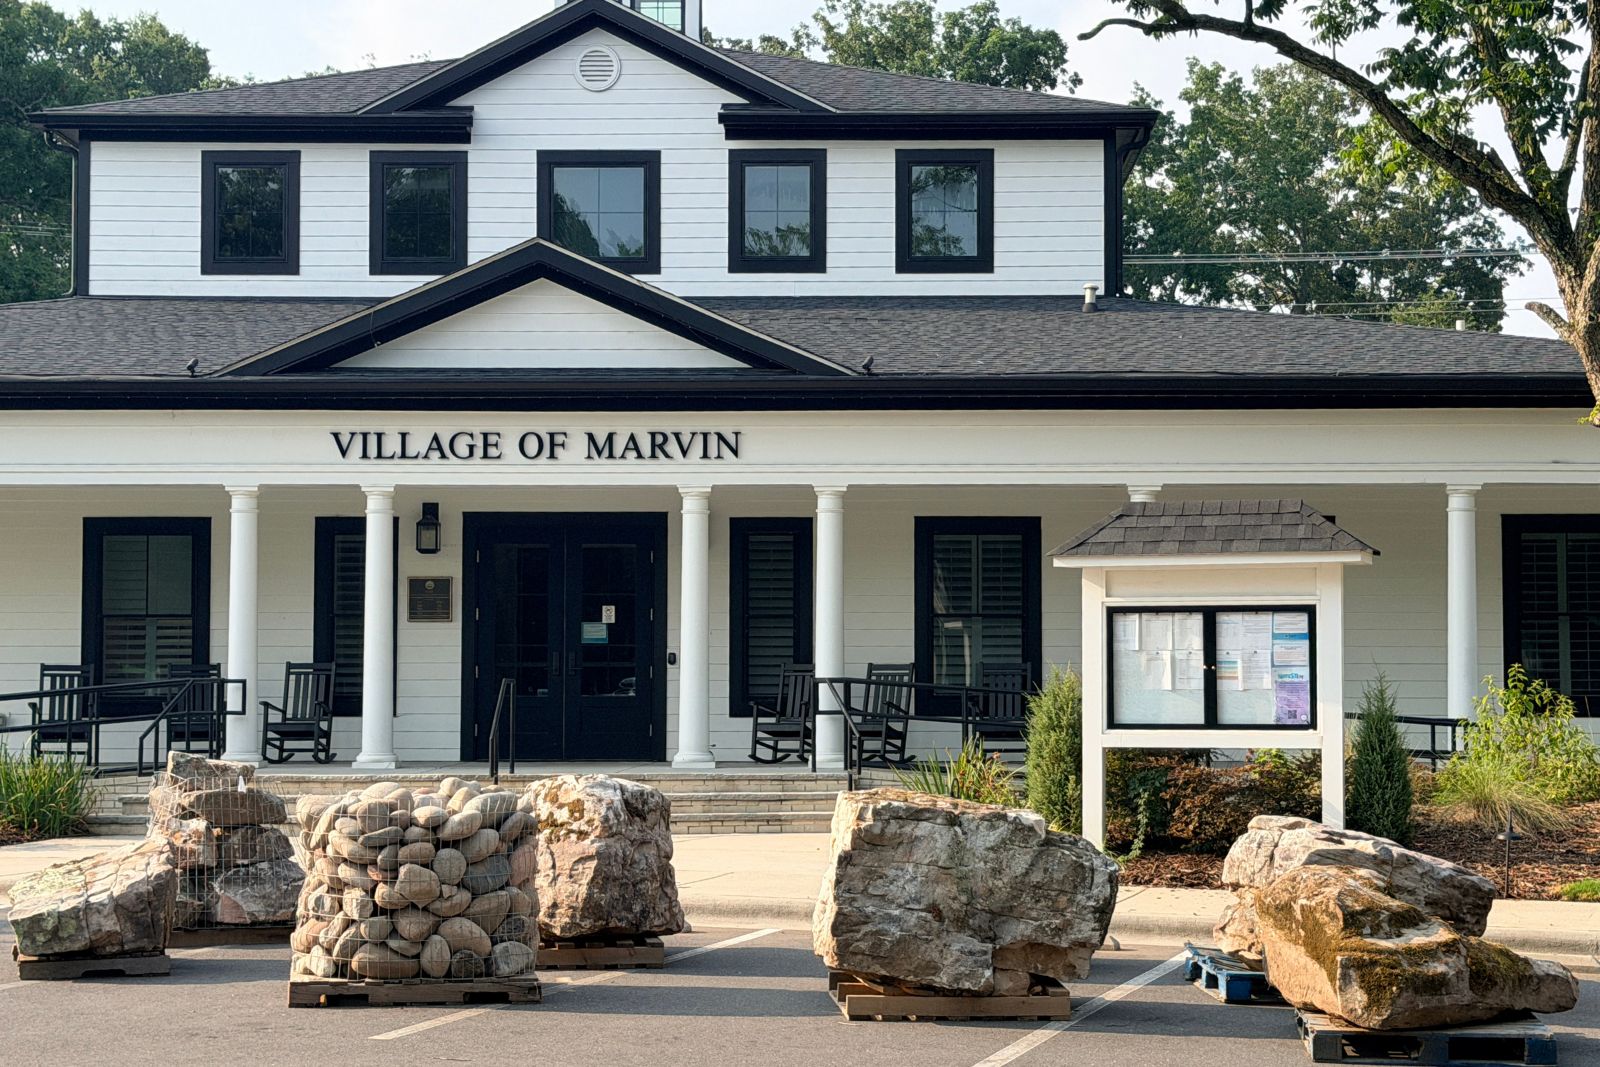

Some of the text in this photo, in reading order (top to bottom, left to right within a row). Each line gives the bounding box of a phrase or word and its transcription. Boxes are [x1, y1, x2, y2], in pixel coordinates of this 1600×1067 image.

[330, 431, 742, 460] VILLAGE OF MARVIN
